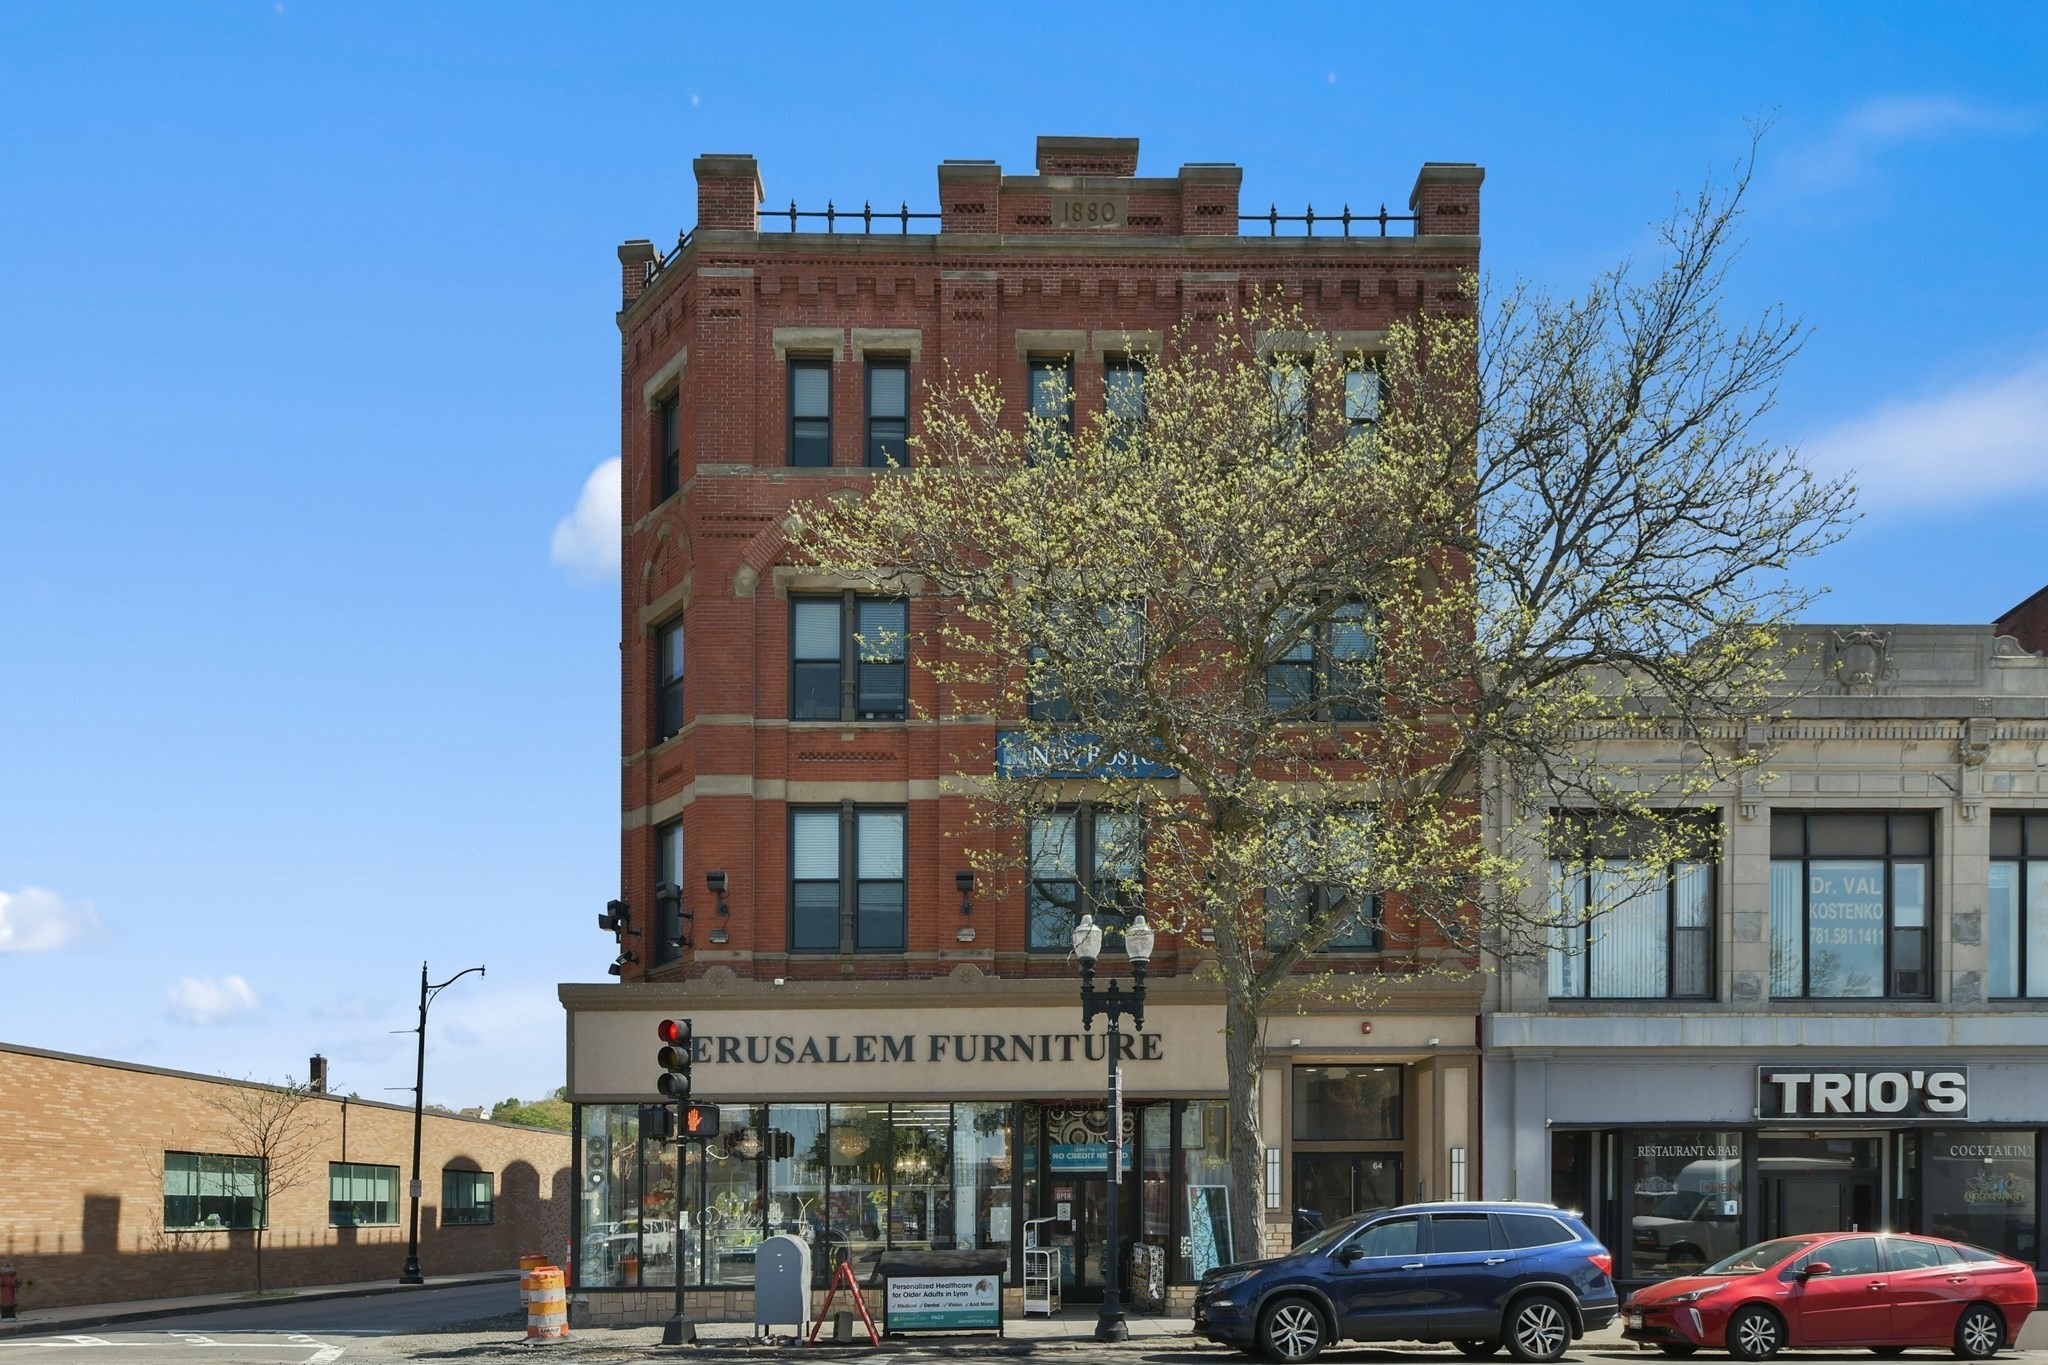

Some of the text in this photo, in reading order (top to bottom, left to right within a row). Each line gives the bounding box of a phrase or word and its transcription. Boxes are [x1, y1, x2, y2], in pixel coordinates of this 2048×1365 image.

[1064, 202, 1116, 222] 1880
[1811, 876, 1882, 895] Dr. VAL
[1809, 902, 1884, 920] KOSTENKO
[1809, 927, 1884, 945] 781.581.1411
[691, 1033, 1164, 1064] ERUSALEM FURNITURE
[1770, 1070, 1968, 1114] TRIO'S
[1637, 1145, 1739, 1157] RESTAURANT & BAR
[1372, 1161, 1383, 1170] 64
[953, 1291, 968, 1299] Lynn
